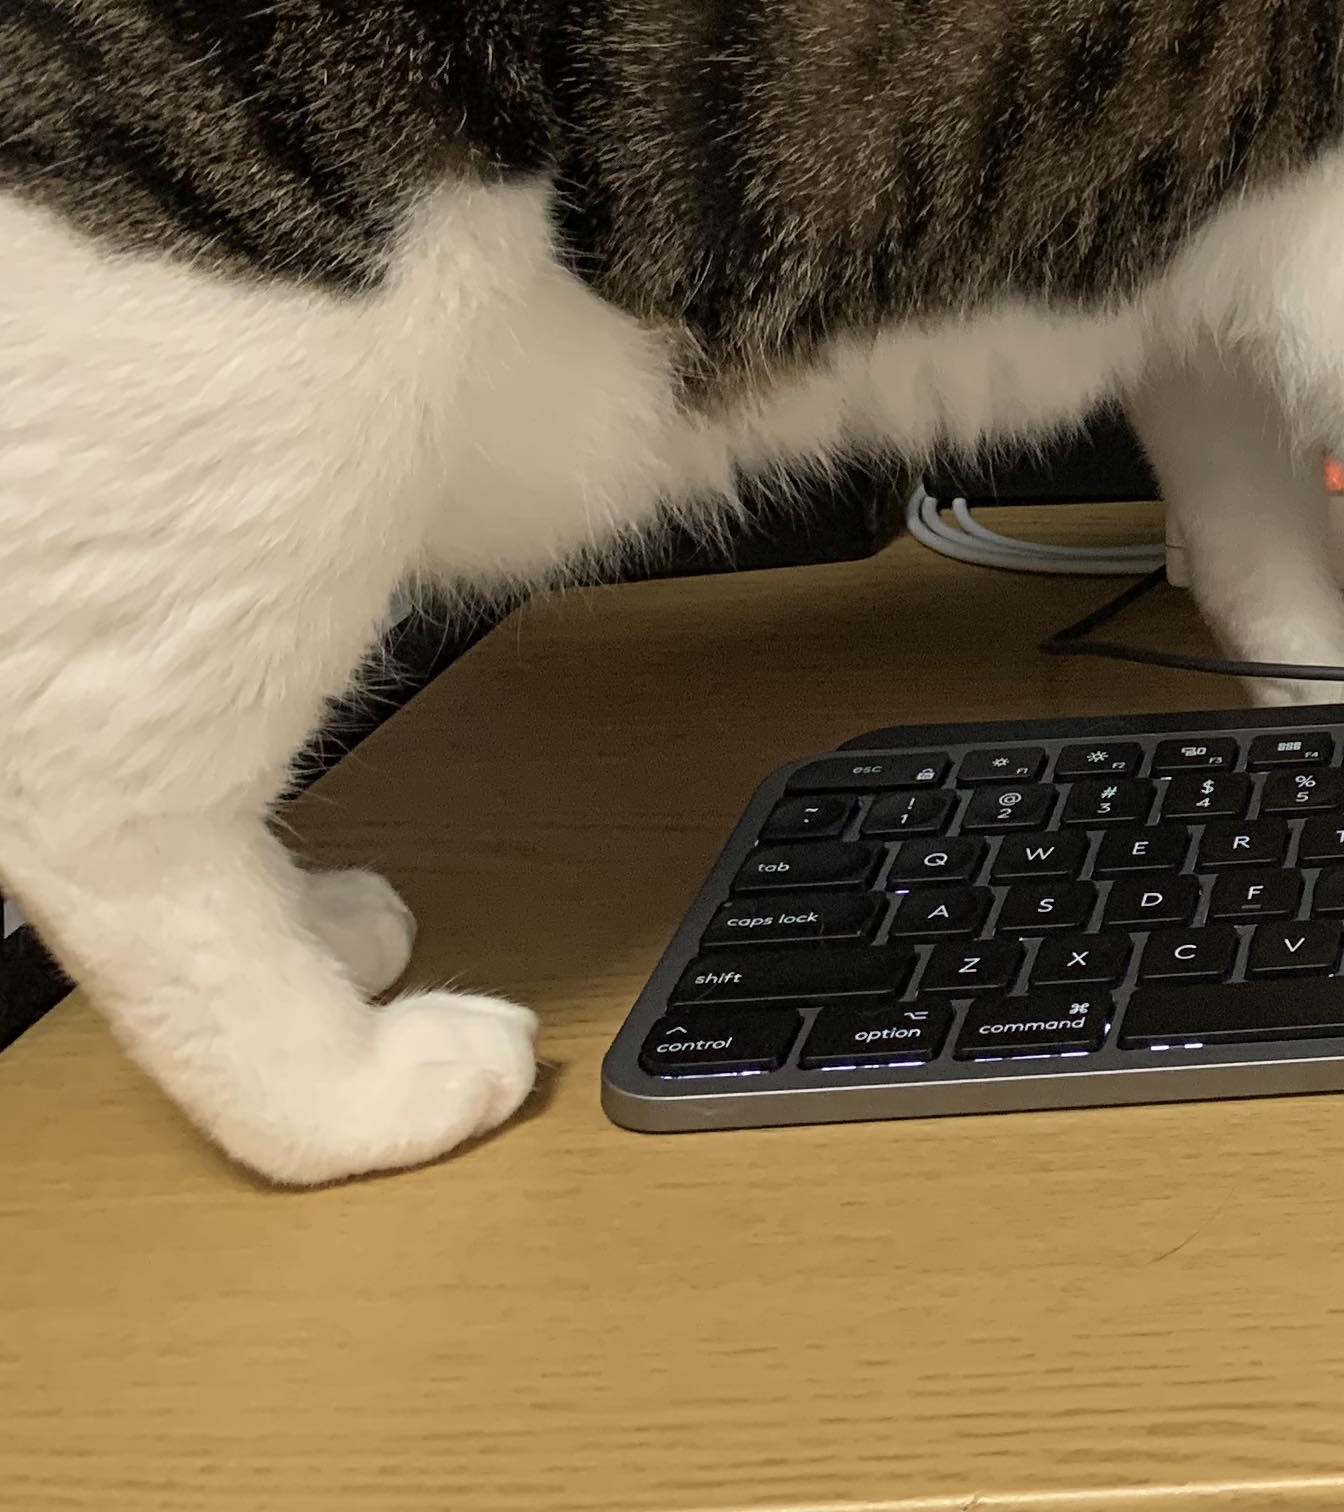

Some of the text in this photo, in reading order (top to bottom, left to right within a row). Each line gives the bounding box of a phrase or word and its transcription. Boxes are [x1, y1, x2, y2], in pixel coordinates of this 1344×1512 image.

[852, 766, 882, 774] esc
[1201, 779, 1215, 795] $
[1295, 774, 1316, 788] %
[1000, 792, 1022, 806] @
[1101, 786, 1118, 799] #
[1296, 791, 1310, 803] 5
[1097, 802, 1112, 814] 3
[1196, 798, 1212, 808] 4
[900, 814, 909, 824] 1
[997, 808, 1012, 819] 2
[1131, 841, 1149, 855] E
[1232, 835, 1250, 849] R
[924, 853, 948, 866] Q
[1025, 846, 1056, 861] W
[758, 862, 790, 872] tab
[1247, 884, 1264, 900] F
[1038, 898, 1056, 912] S
[1140, 892, 1163, 907] D
[927, 904, 950, 919] A
[727, 912, 820, 928] caps lock
[1284, 936, 1306, 952] V
[1066, 951, 1090, 967] X
[1174, 944, 1198, 960] C
[958, 957, 980, 973] Z
[695, 972, 742, 984] shift
[979, 1017, 1086, 1034] command
[854, 1027, 922, 1042] option
[656, 1037, 733, 1054] control
